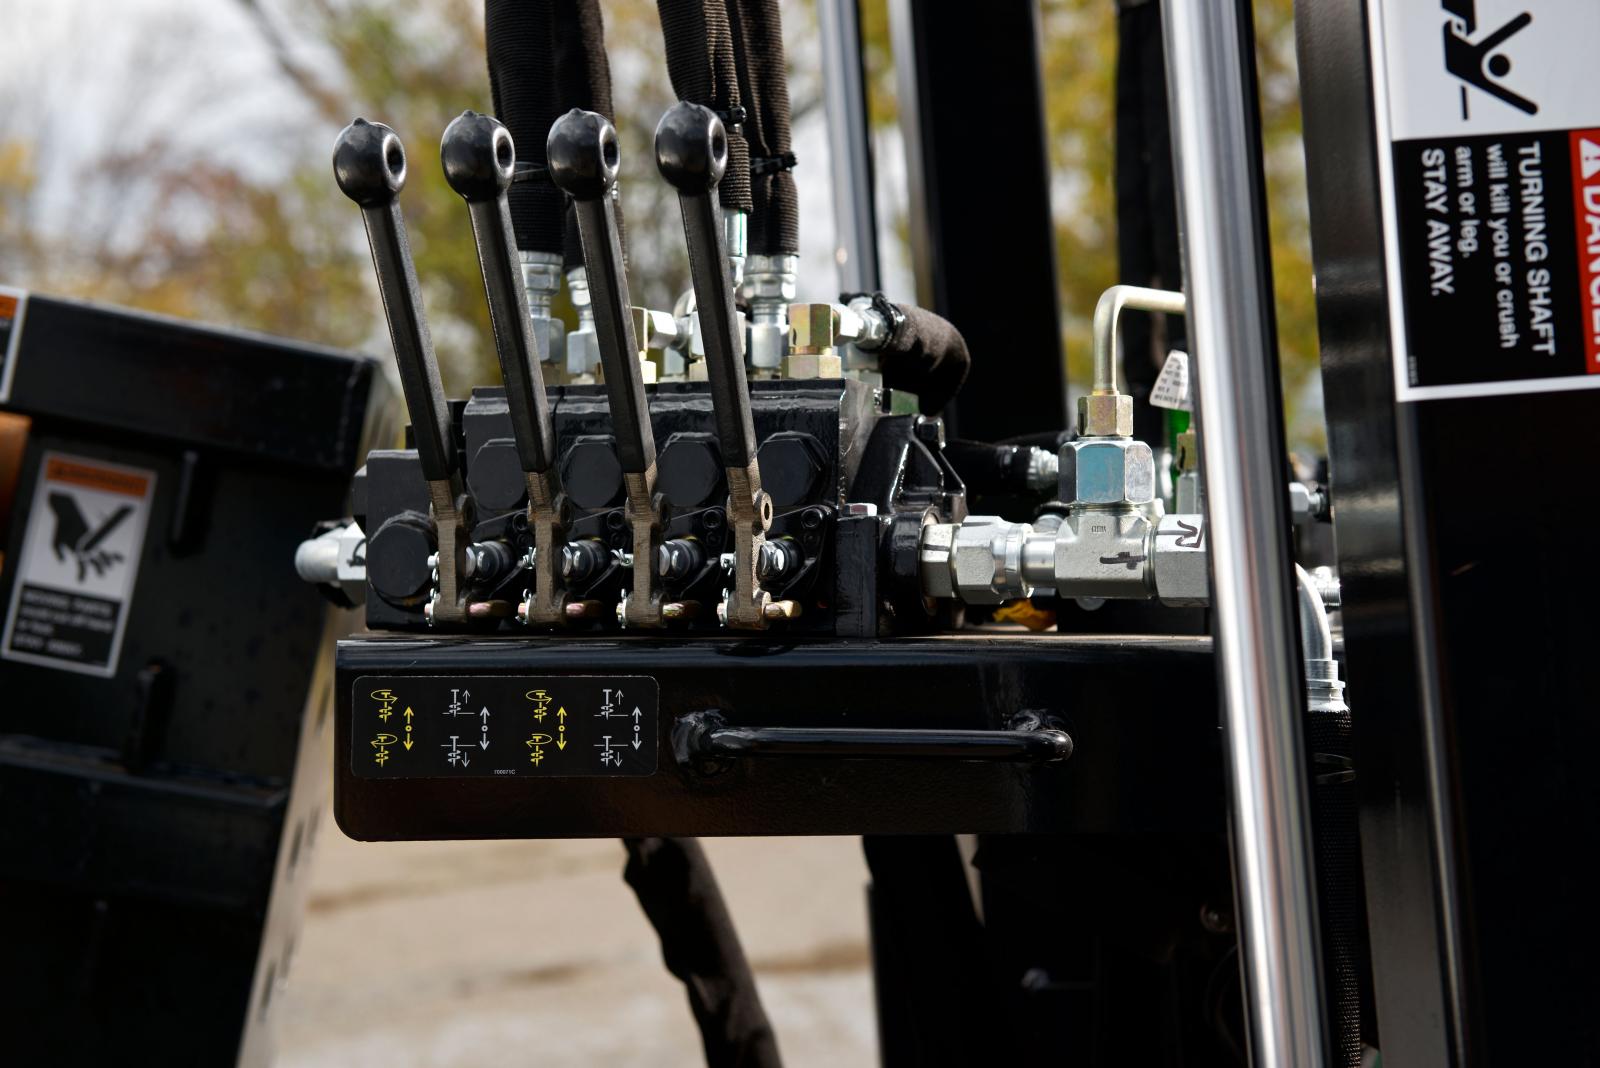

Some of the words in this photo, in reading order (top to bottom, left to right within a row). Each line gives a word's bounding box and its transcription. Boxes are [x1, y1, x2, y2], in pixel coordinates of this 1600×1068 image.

[1421, 148, 1449, 214] STAY
[1455, 146, 1474, 188] arm
[1486, 143, 1508, 179] will
[1458, 191, 1476, 215] or
[1489, 183, 1511, 214] kill
[1518, 140, 1548, 262] TURNING
[1427, 219, 1455, 297] AWAY.
[1457, 218, 1480, 258] leg.
[1487, 218, 1510, 258] you
[1494, 262, 1512, 285] or
[1496, 289, 1520, 348] crush
[1526, 268, 1556, 356] SHAFT
